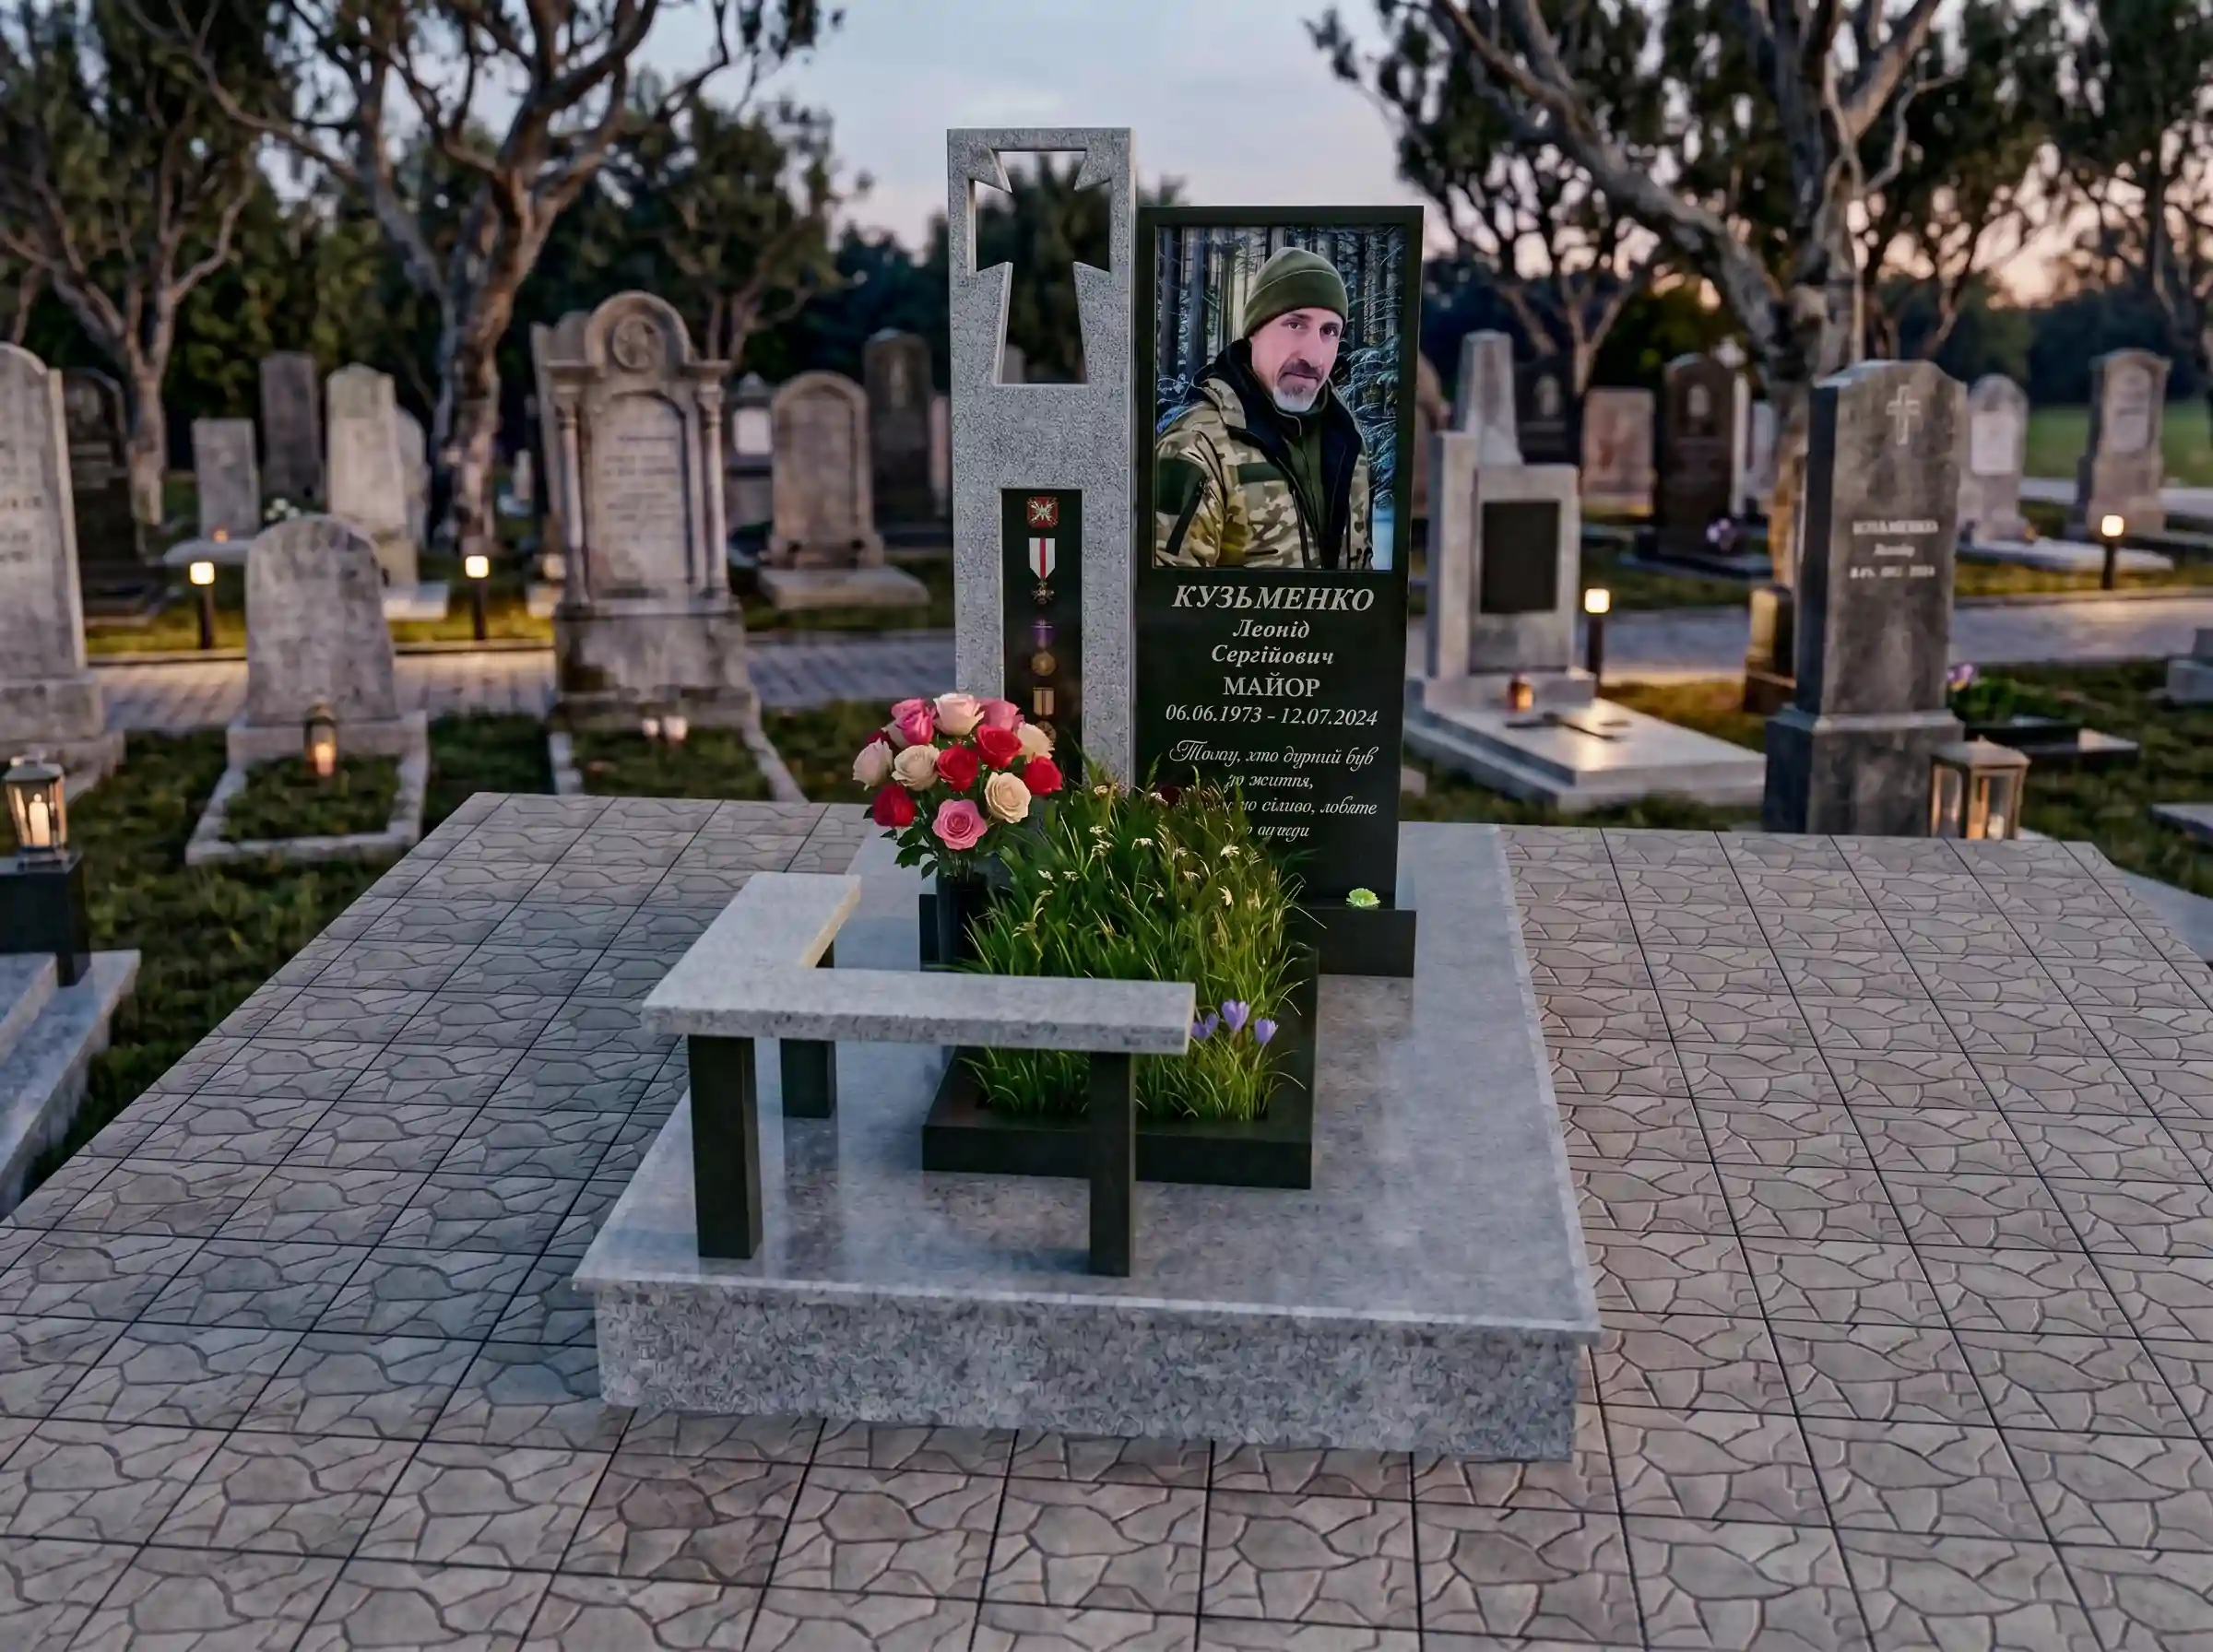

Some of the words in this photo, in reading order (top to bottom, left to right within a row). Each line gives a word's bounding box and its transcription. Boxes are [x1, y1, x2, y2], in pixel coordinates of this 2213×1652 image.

[1171, 584, 1375, 611] КУЗЬМЕНКО
[1233, 619, 1310, 639] Леонід
[1212, 644, 1334, 667] Сергійович
[1222, 672, 1320, 698] МАЙОР
[1166, 703, 1262, 723] 06.06.1973
[1280, 707, 1379, 726] 12.07.2024
[1345, 746, 1379, 773] був
